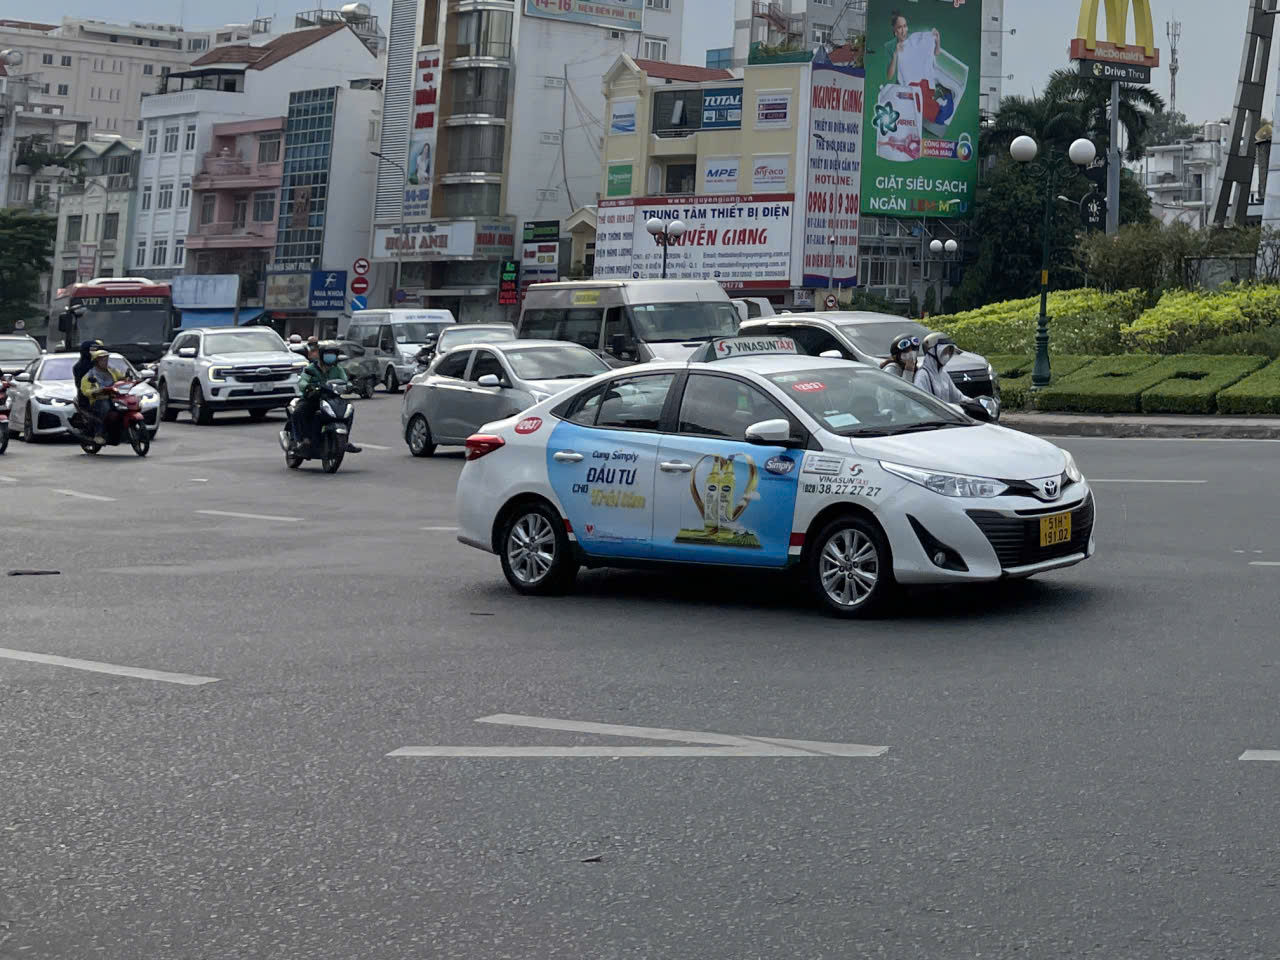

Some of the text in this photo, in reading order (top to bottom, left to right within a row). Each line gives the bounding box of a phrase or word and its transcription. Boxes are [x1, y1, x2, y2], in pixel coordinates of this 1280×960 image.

[1095, 49, 1144, 61] McDonald's
[1104, 66, 1144, 79] Drive Thru
[704, 95, 741, 106] TOTAL
[842, 88, 862, 113] GIANG
[897, 119, 916, 128] ARIEL
[847, 142, 855, 152] LED
[706, 168, 737, 177] MPE
[815, 174, 854, 186] HOTLINE:
[876, 174, 967, 195] GIẶT SIÊU SẠCH
[668, 196, 753, 204] www.nguyengiang.vn
[808, 191, 858, 214] 0906 89 300
[869, 195, 907, 210] NGĂN
[643, 203, 789, 220] TRUNG TÂM THIẾT BỊ ĐIỆN
[419, 234, 448, 249] ANH
[722, 228, 767, 246] GIANG
[824, 253, 833, 267] BIÊ
[105, 297, 163, 305] LIMOUSINE
[518, 420, 538, 430] 12037
[612, 449, 639, 463] Simply
[766, 458, 794, 472] Simply
[586, 463, 638, 485] ĐẦU TƯ
[572, 484, 588, 493] CHO
[1049, 515, 1063, 530] 51H
